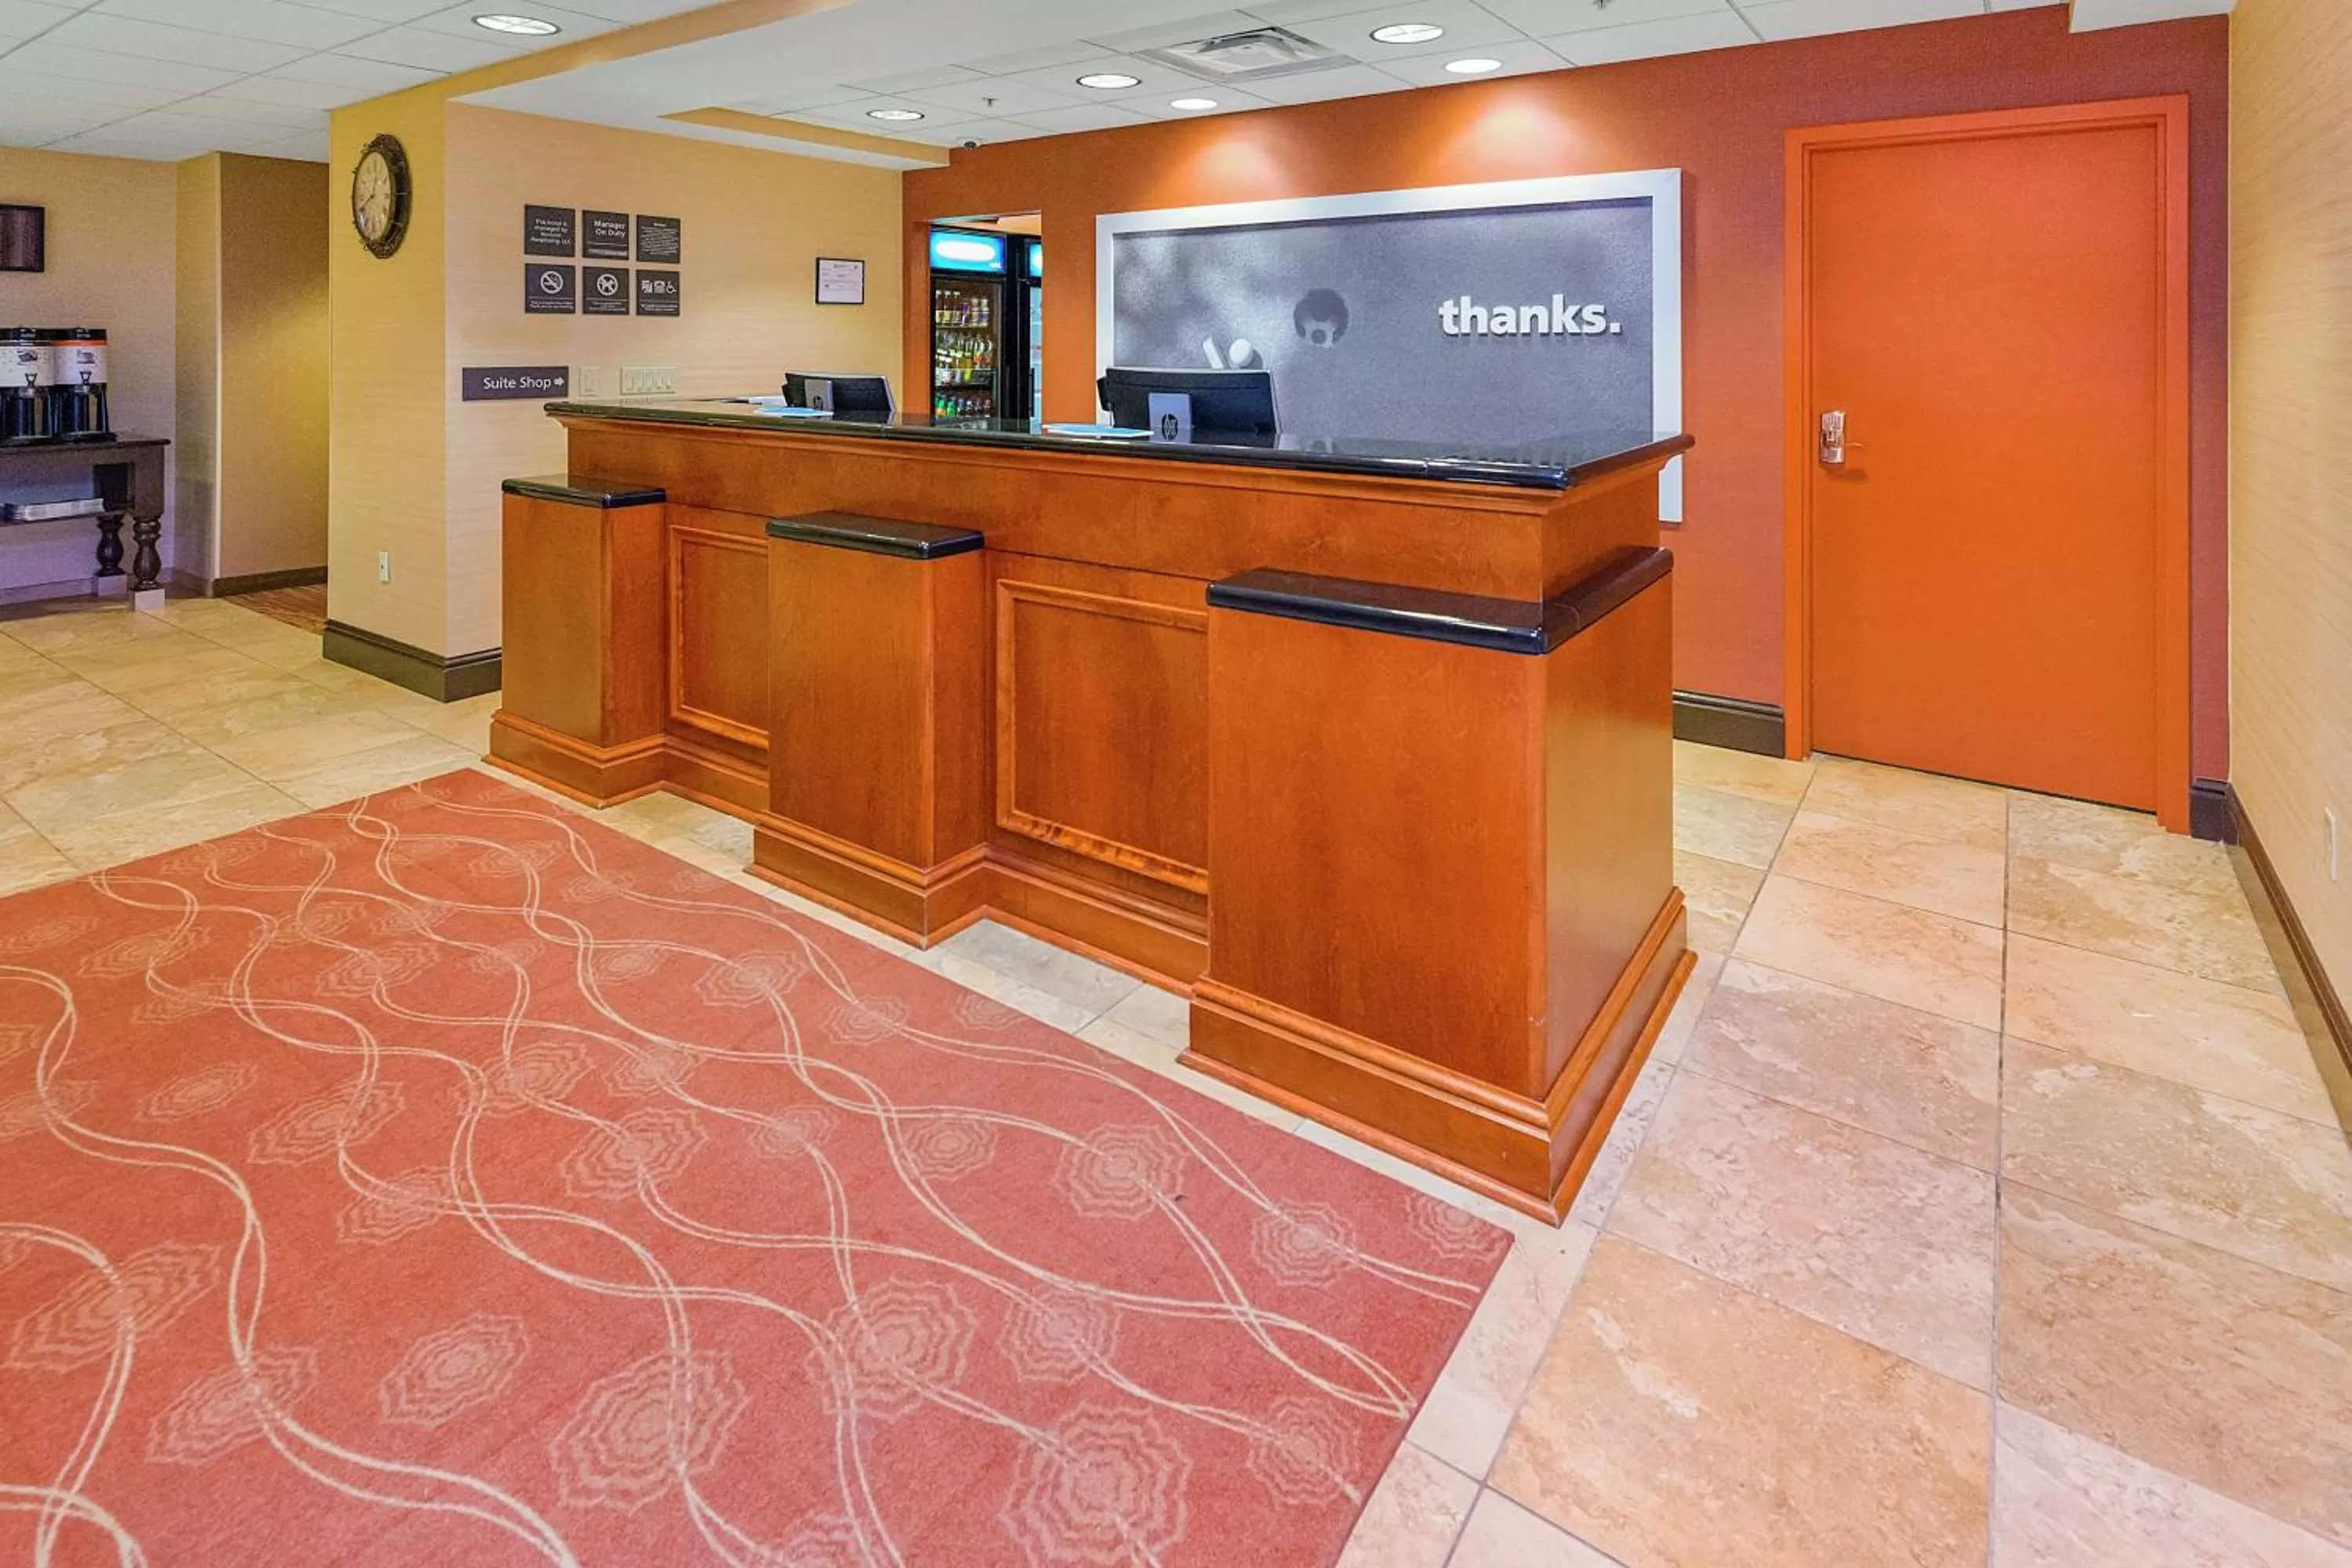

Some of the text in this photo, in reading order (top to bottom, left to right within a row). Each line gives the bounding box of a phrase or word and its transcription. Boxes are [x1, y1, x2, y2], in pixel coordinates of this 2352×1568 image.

[593, 220, 626, 230] Manager
[608, 229, 626, 238] Duty
[1438, 294, 1621, 336] thanks.
[483, 376, 551, 390] Suite Shop
